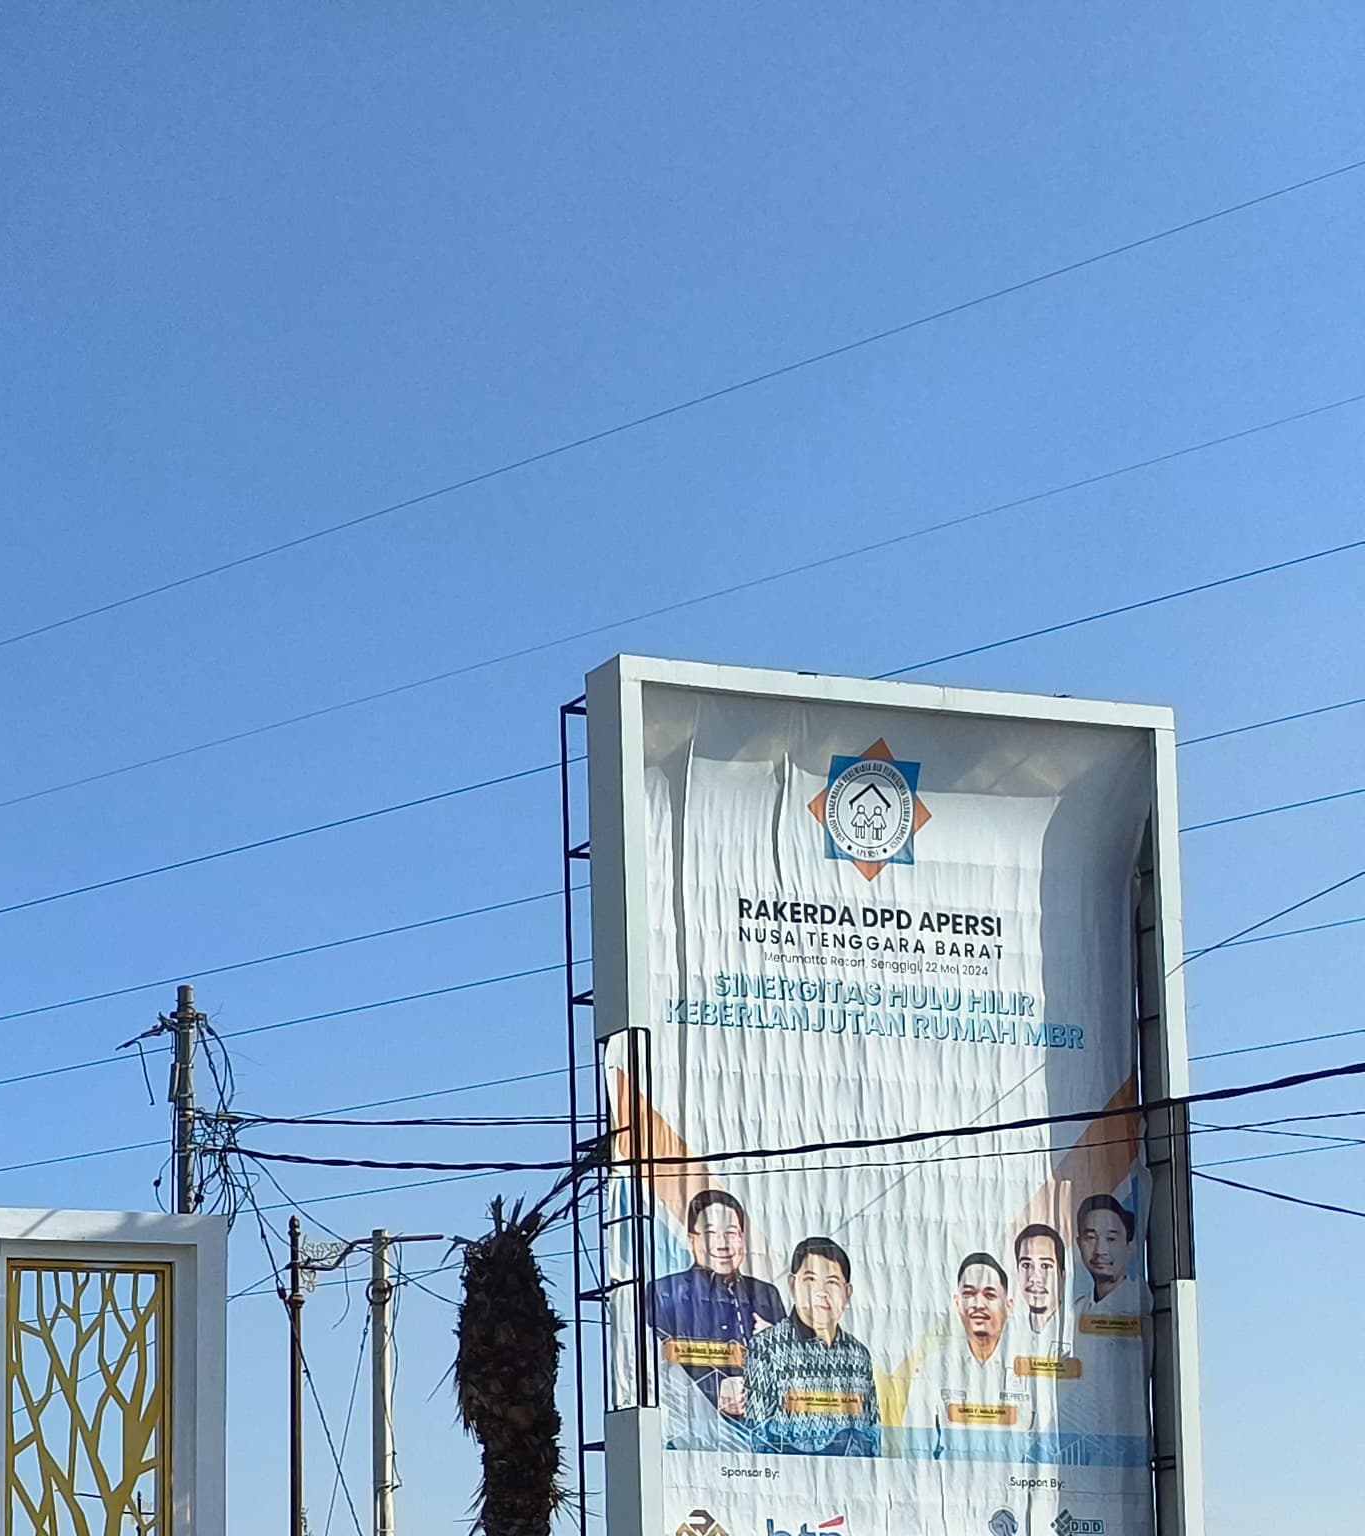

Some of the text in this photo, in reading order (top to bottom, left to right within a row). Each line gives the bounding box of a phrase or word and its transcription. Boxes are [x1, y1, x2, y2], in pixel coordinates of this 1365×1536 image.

[738, 898, 1003, 938] RAKERDA DPD APERSI
[738, 926, 1004, 960] NUSA TENGGARA BARAT
[925, 962, 938, 973] 22
[962, 965, 989, 977] 2024
[714, 971, 1035, 1018] SINERGITAS HULU HILIR
[665, 998, 1086, 1050] KEBERLANJUTAN RUMAH MBR
[720, 1466, 780, 1481] Sponsor By:
[1010, 1476, 1066, 1490] Support By:
